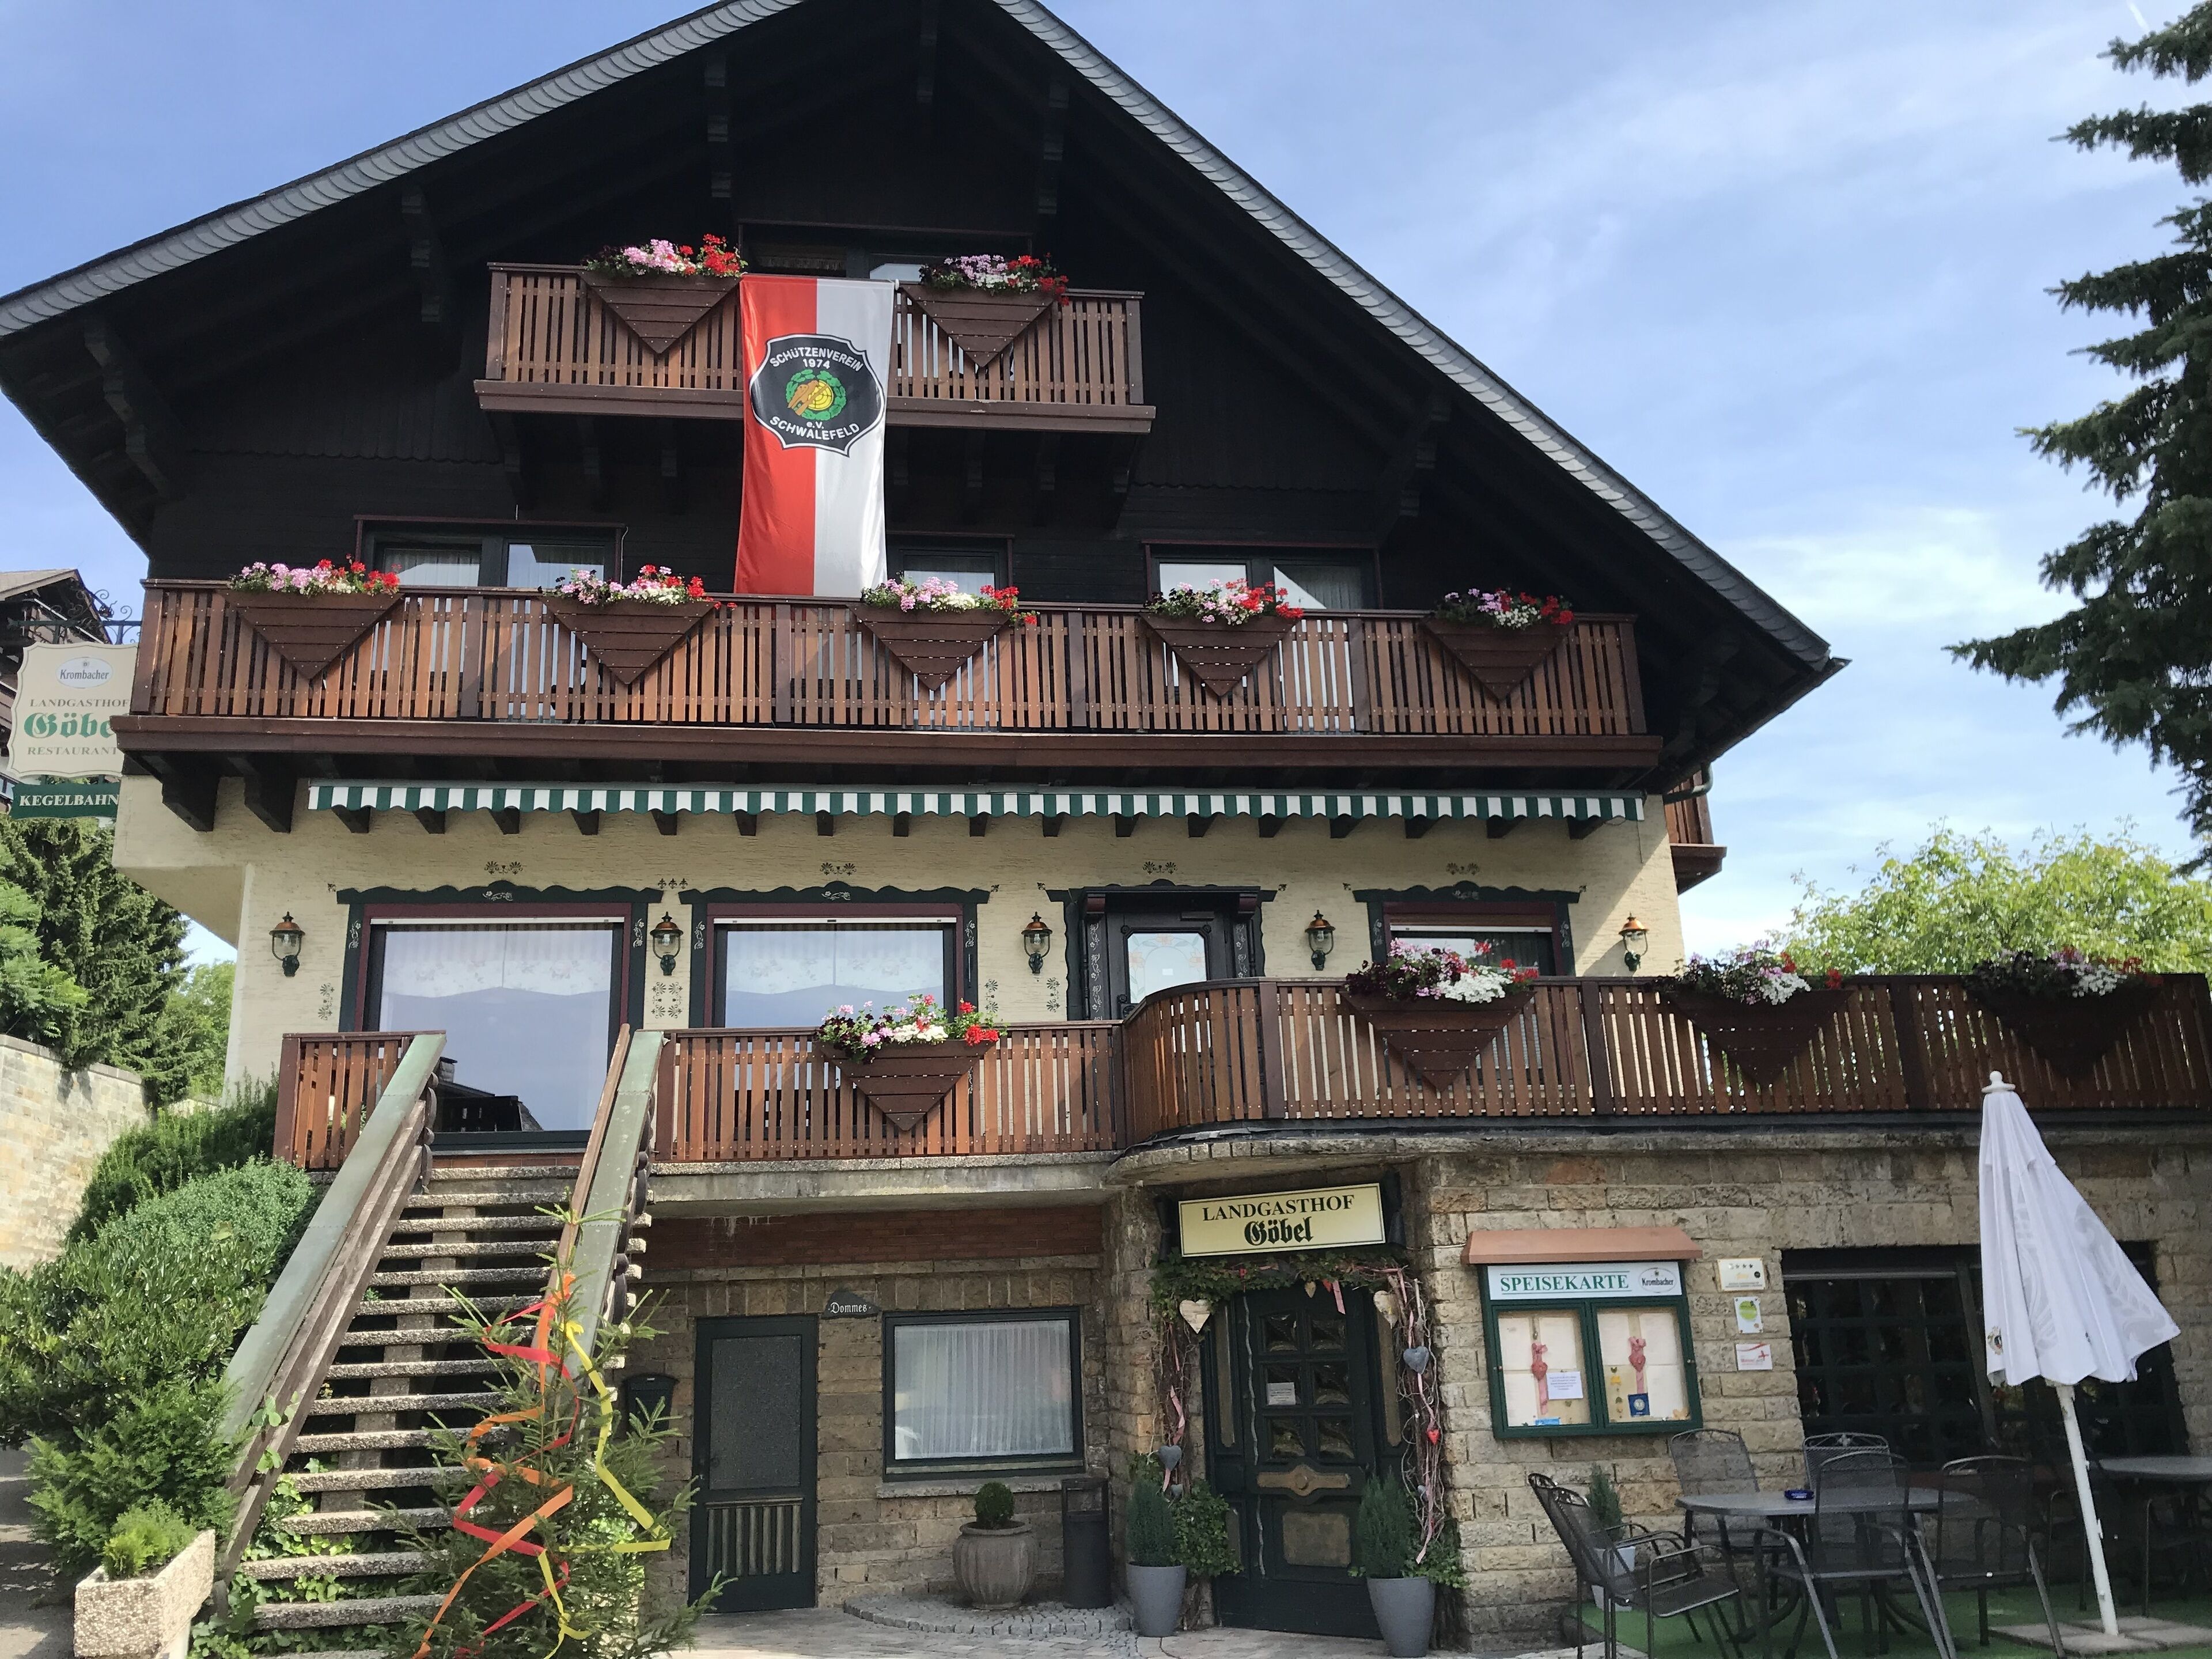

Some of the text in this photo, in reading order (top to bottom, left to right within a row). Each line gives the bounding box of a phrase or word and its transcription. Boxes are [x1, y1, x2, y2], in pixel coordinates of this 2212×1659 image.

[770, 347, 863, 372] SCHÜTZENVEREIN
[803, 359, 831, 369] 1974
[770, 416, 860, 440] SCHWALEFELD
[806, 421, 824, 429] e.V.
[60, 669, 109, 680] Krombacher
[30, 699, 130, 707] LANDGASTHOF
[24, 713, 119, 738] Göbe
[28, 747, 118, 755] RESTAURANT
[19, 794, 119, 806] KEGELBAHN
[1203, 1194, 1355, 1221] LANDGASTHOF
[1244, 1216, 1315, 1246] Göbel
[1500, 1274, 1630, 1292] SPEISEKARTE
[1641, 1277, 1674, 1286] Krombacher
[830, 1302, 868, 1313] Dommes
